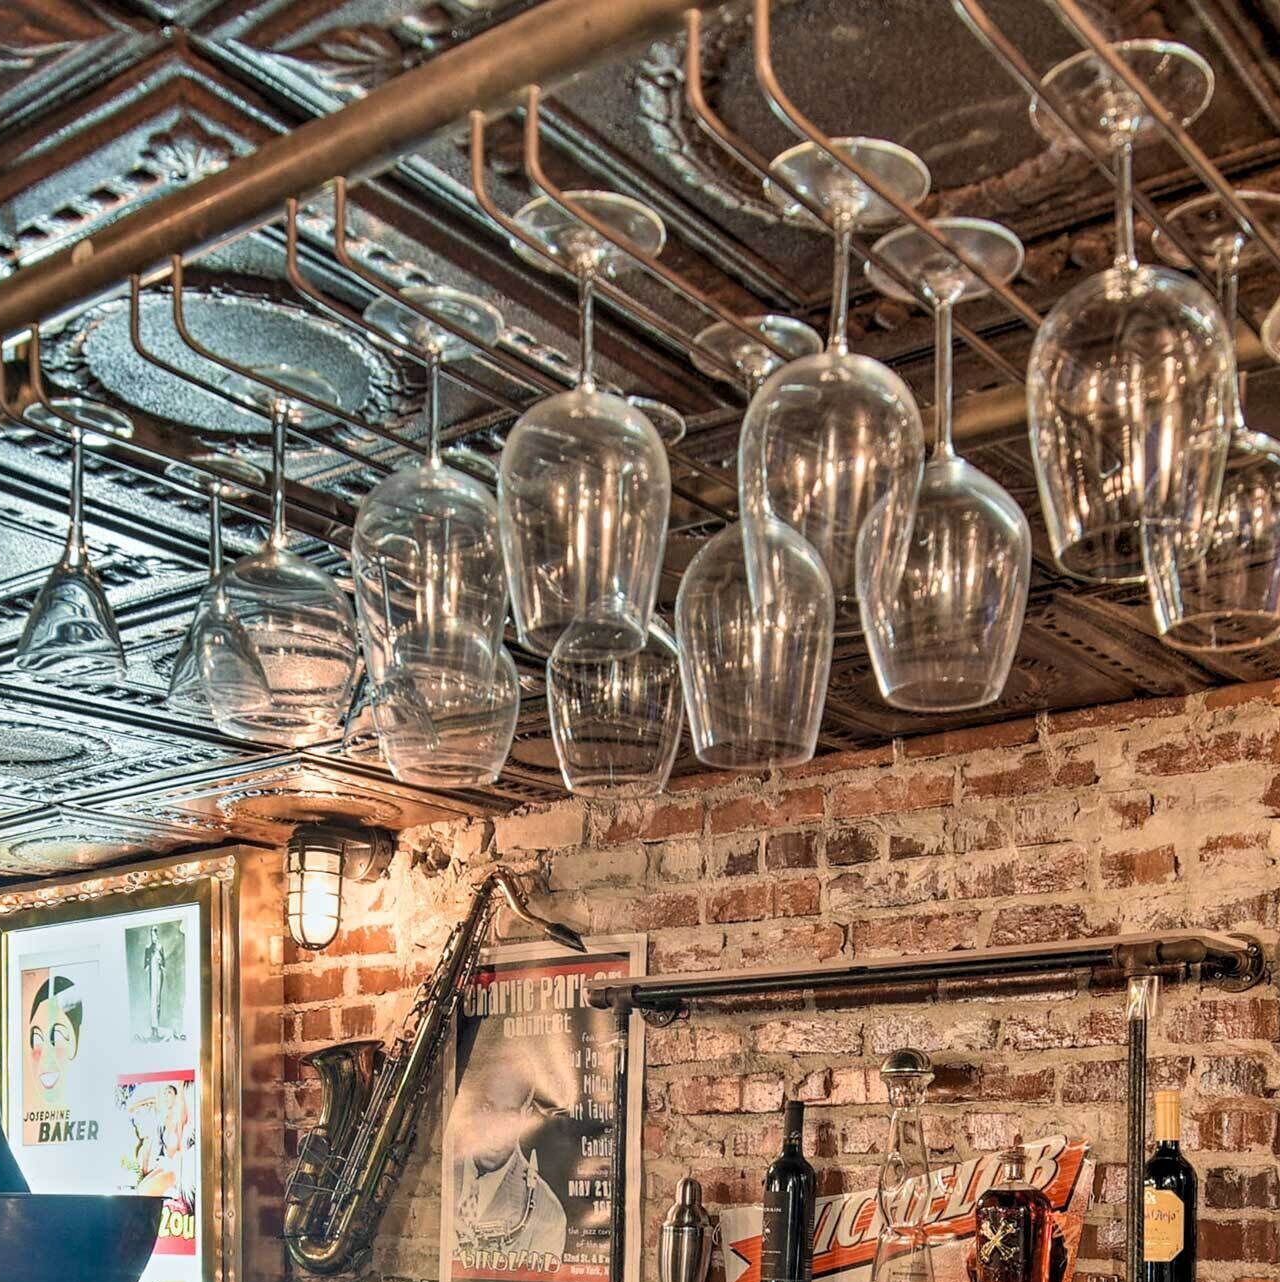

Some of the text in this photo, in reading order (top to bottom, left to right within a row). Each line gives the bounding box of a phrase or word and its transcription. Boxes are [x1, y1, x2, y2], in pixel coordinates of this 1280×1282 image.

[463, 979, 534, 1017] Charlie
[23, 1109, 71, 1123] JOSEPHINE
[38, 1120, 99, 1143] BAKER
[810, 1133, 1068, 1252] ICHELOB
[458, 1250, 562, 1273] BIRDLAND
